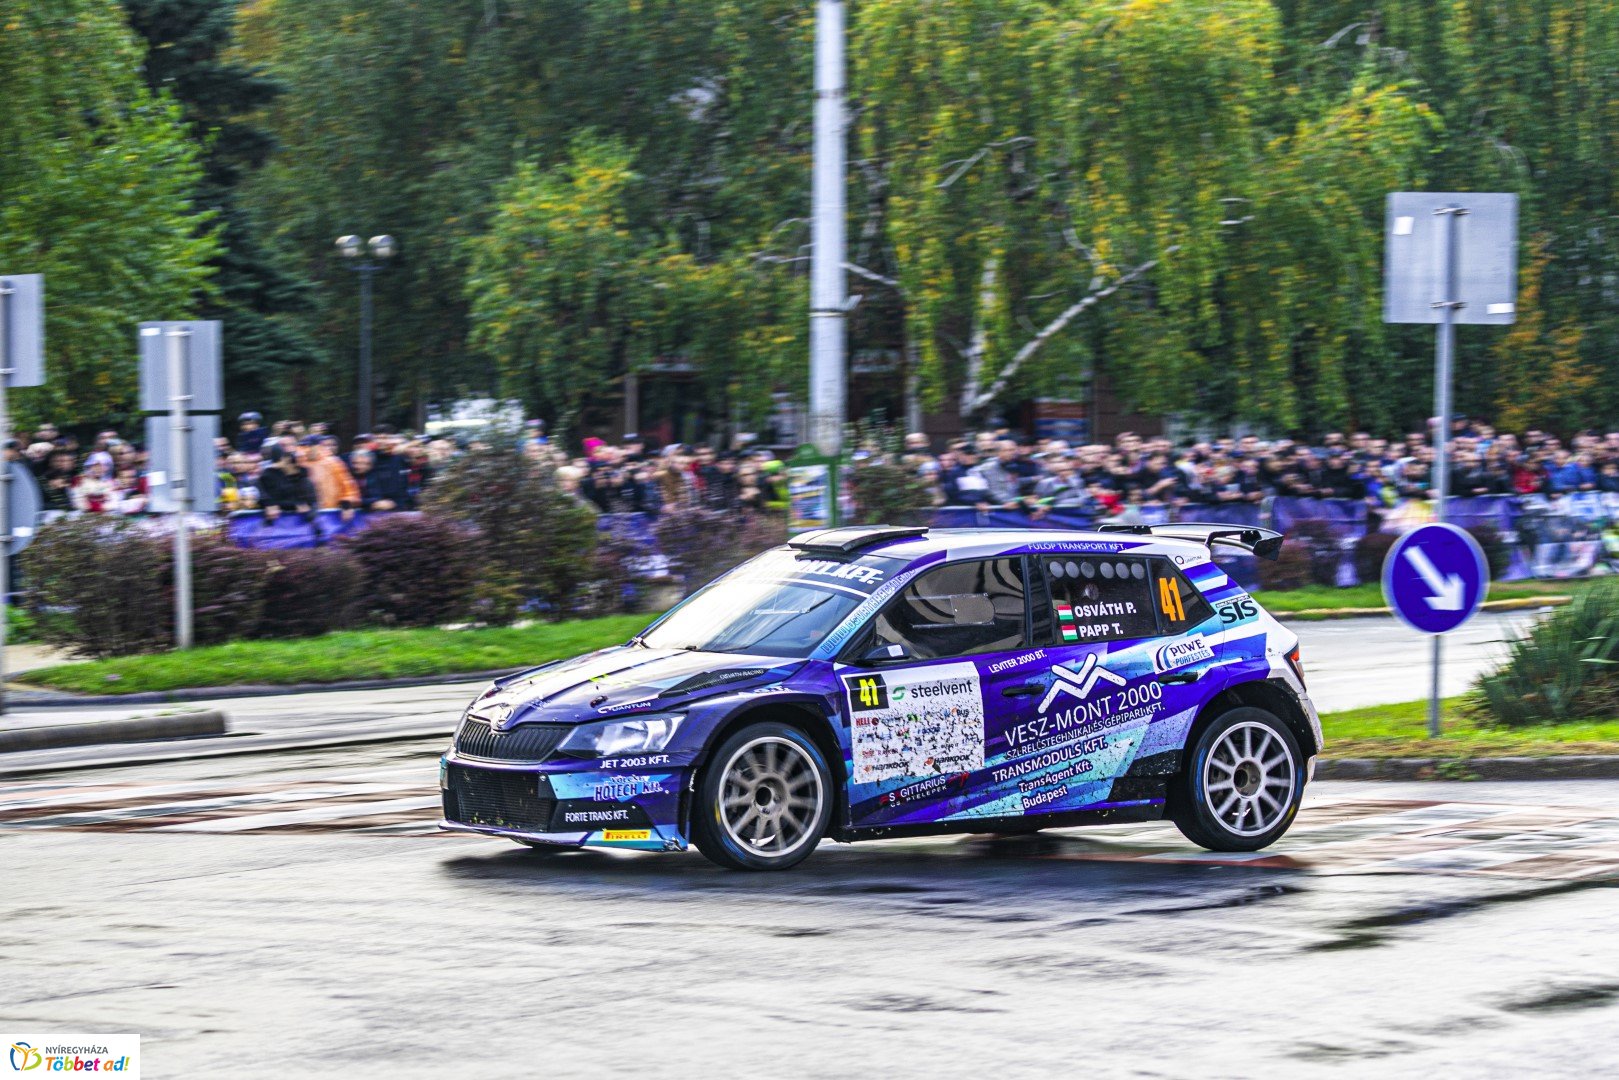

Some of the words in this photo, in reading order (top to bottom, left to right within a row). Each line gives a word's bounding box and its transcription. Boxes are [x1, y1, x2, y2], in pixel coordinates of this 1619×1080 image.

[1058, 542, 1107, 550] TRANSPORT
[1074, 601, 1125, 618] OSVÁTH
[1128, 601, 1137, 614] P.
[1159, 577, 1185, 621] 41
[1079, 624, 1108, 638] PAPP
[1112, 623, 1124, 635] T.
[988, 659, 1019, 674] LEVITER
[1017, 652, 1036, 667] 2000
[1036, 650, 1048, 660] BT.
[860, 678, 879, 706] 41
[911, 680, 973, 699] steelvent
[856, 717, 871, 726] HELL
[1005, 695, 1112, 747] VESZ-MONT
[1117, 681, 1163, 711] 2000
[1105, 709, 1146, 729] GÉPIPARI
[1146, 702, 1166, 716] KFT.
[600, 759, 619, 769] JET
[620, 757, 647, 768] 2003
[649, 754, 671, 765] KFT.
[991, 744, 1082, 783] TRANSMODULS
[1083, 736, 1109, 755] KFT.
[889, 775, 946, 802] SGITTARIUS
[1018, 770, 1074, 793] TransAgent
[1075, 761, 1093, 776] Kft.
[1022, 785, 1068, 809] Budapest
[565, 812, 588, 822] FORTE
[588, 811, 613, 821] TRANS
[613, 809, 629, 819] KFT.
